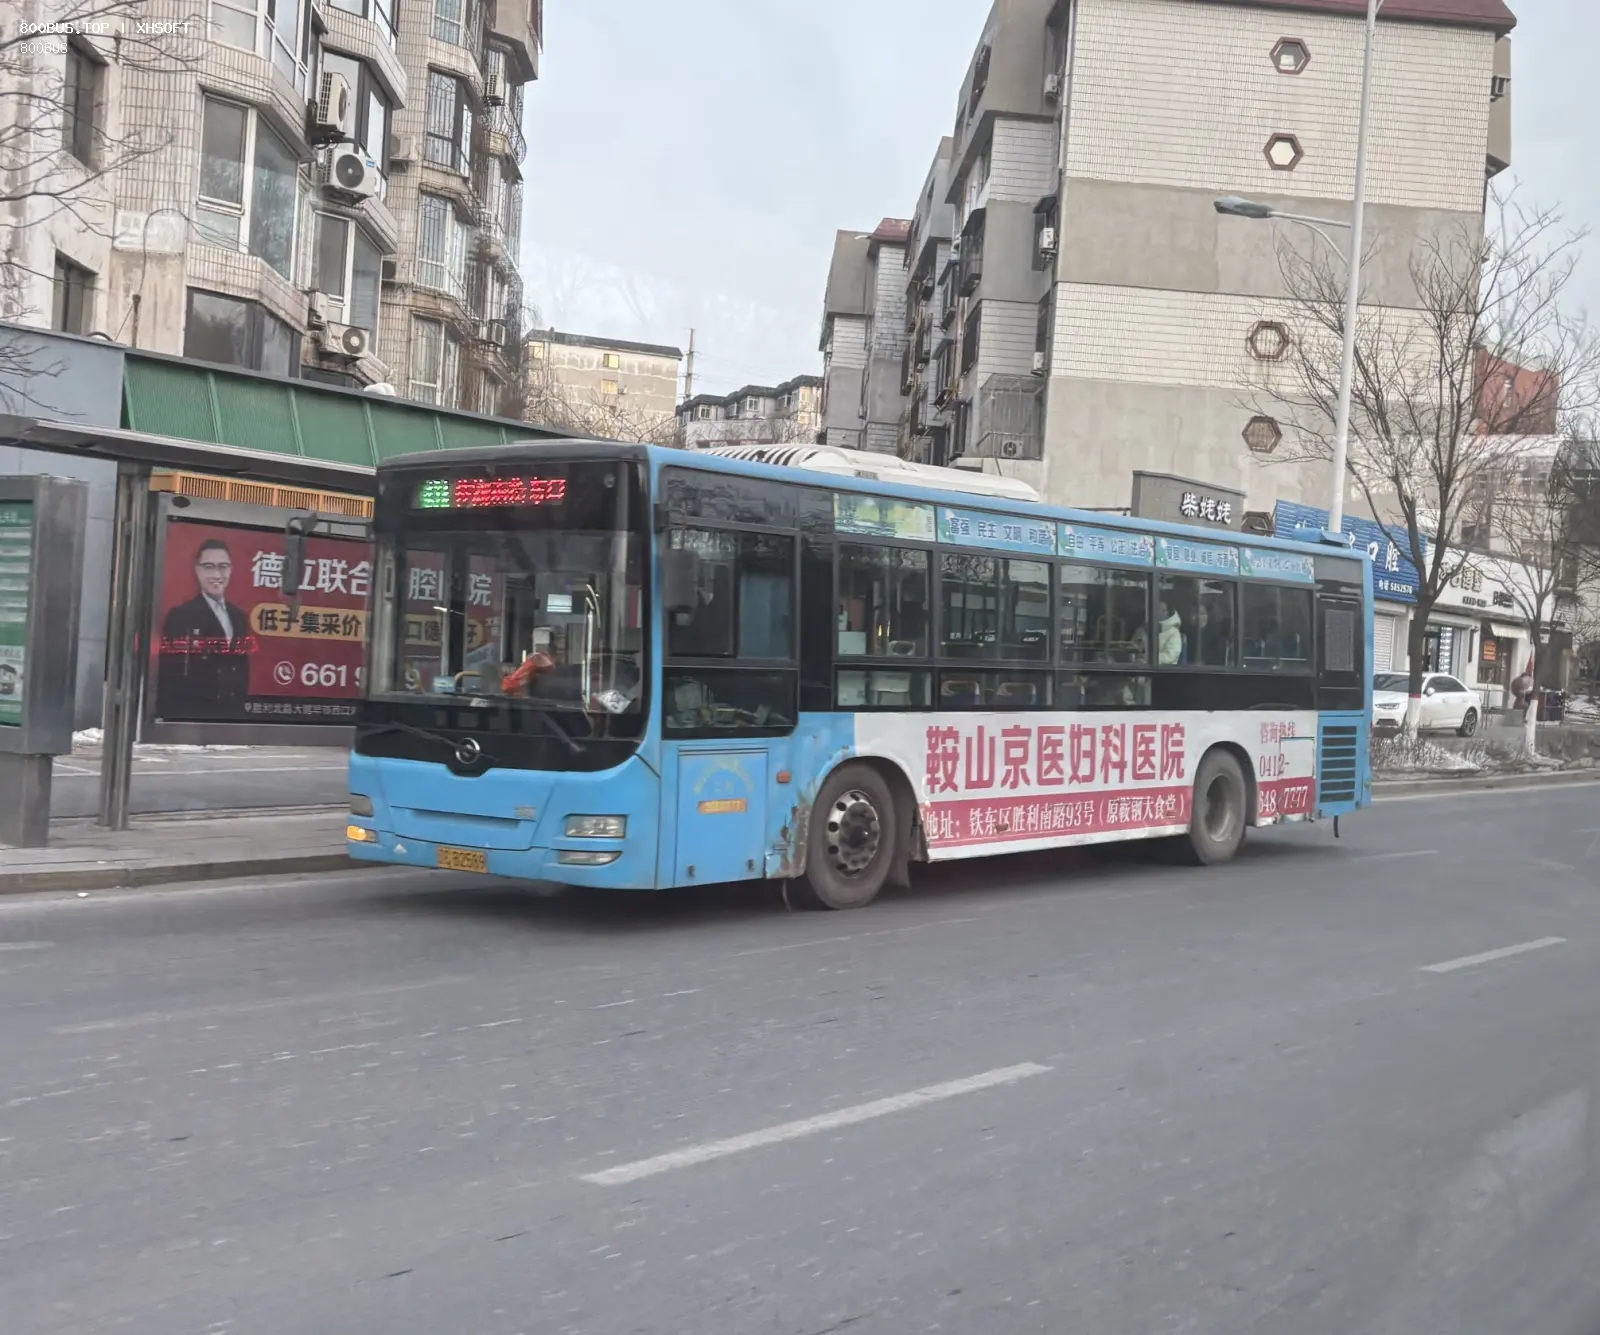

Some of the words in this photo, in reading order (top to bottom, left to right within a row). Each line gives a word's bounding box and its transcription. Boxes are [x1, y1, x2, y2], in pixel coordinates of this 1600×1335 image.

[301, 662, 348, 687] 661
[926, 722, 1186, 795] 鞍山京医妇科医院
